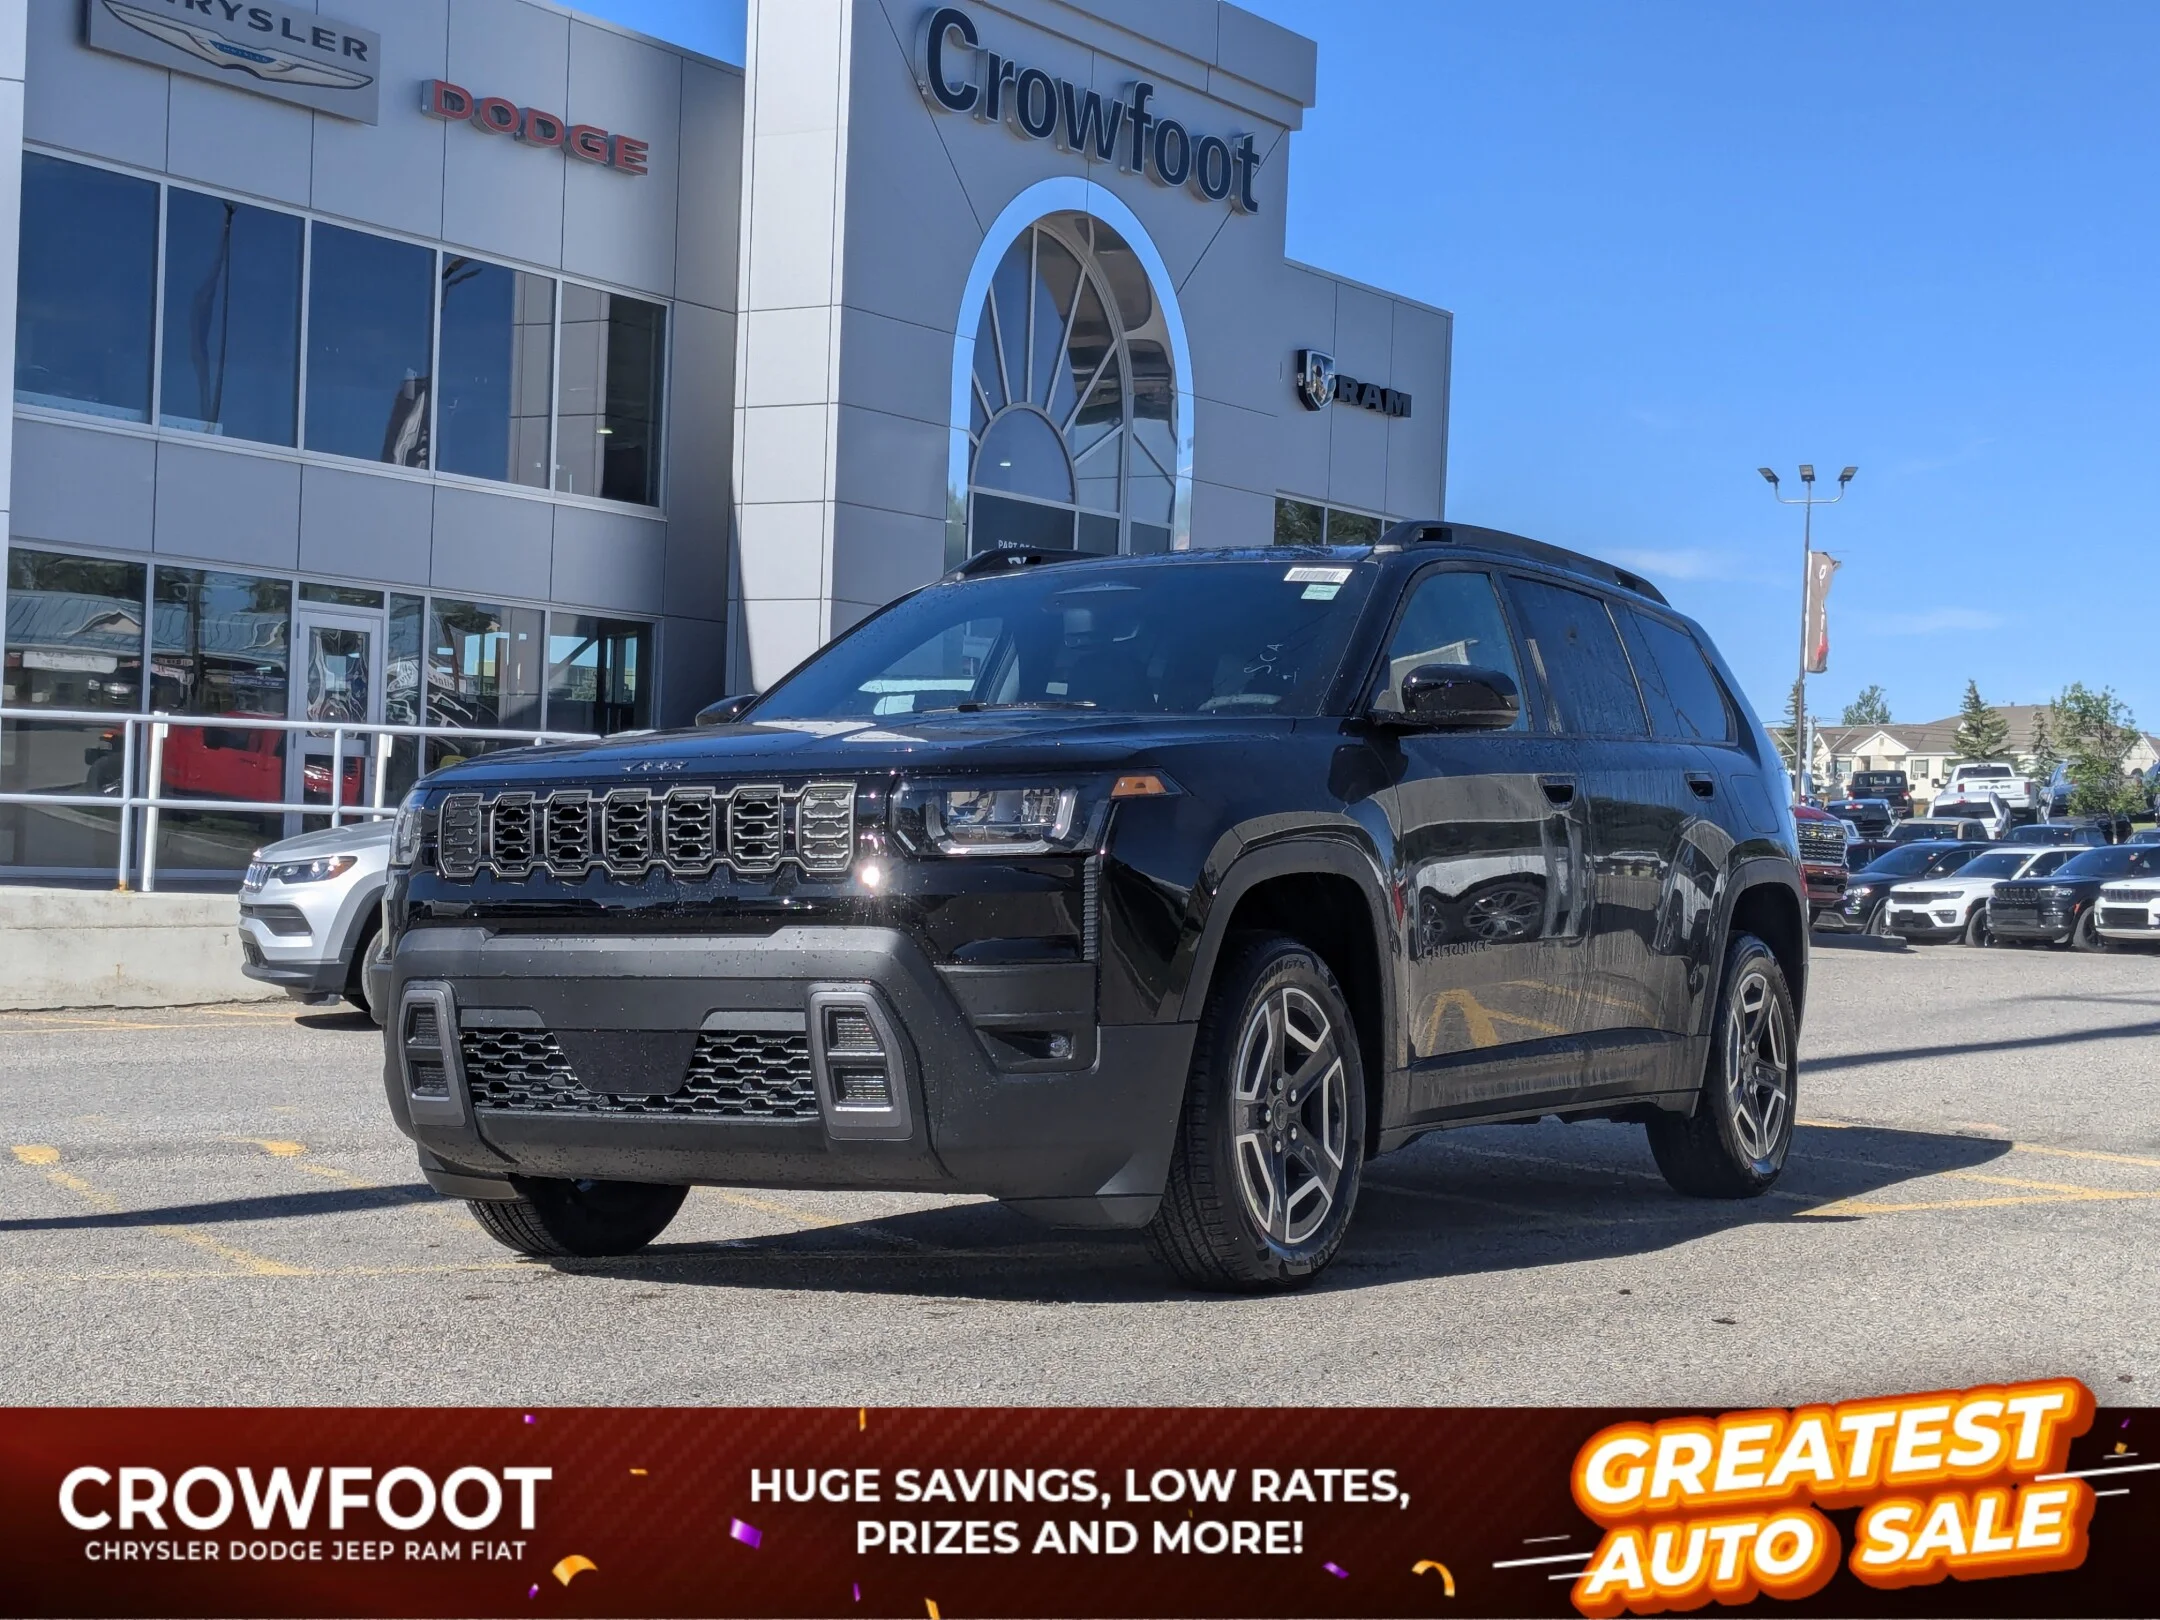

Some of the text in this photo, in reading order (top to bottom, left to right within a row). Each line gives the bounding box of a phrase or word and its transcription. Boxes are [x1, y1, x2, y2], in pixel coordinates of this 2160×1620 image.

[425, 79, 649, 176] DODGE
[918, 6, 1260, 214] Crowfoot
[1336, 374, 1412, 418] RAM
[1422, 940, 1493, 958] CHEROKEE
